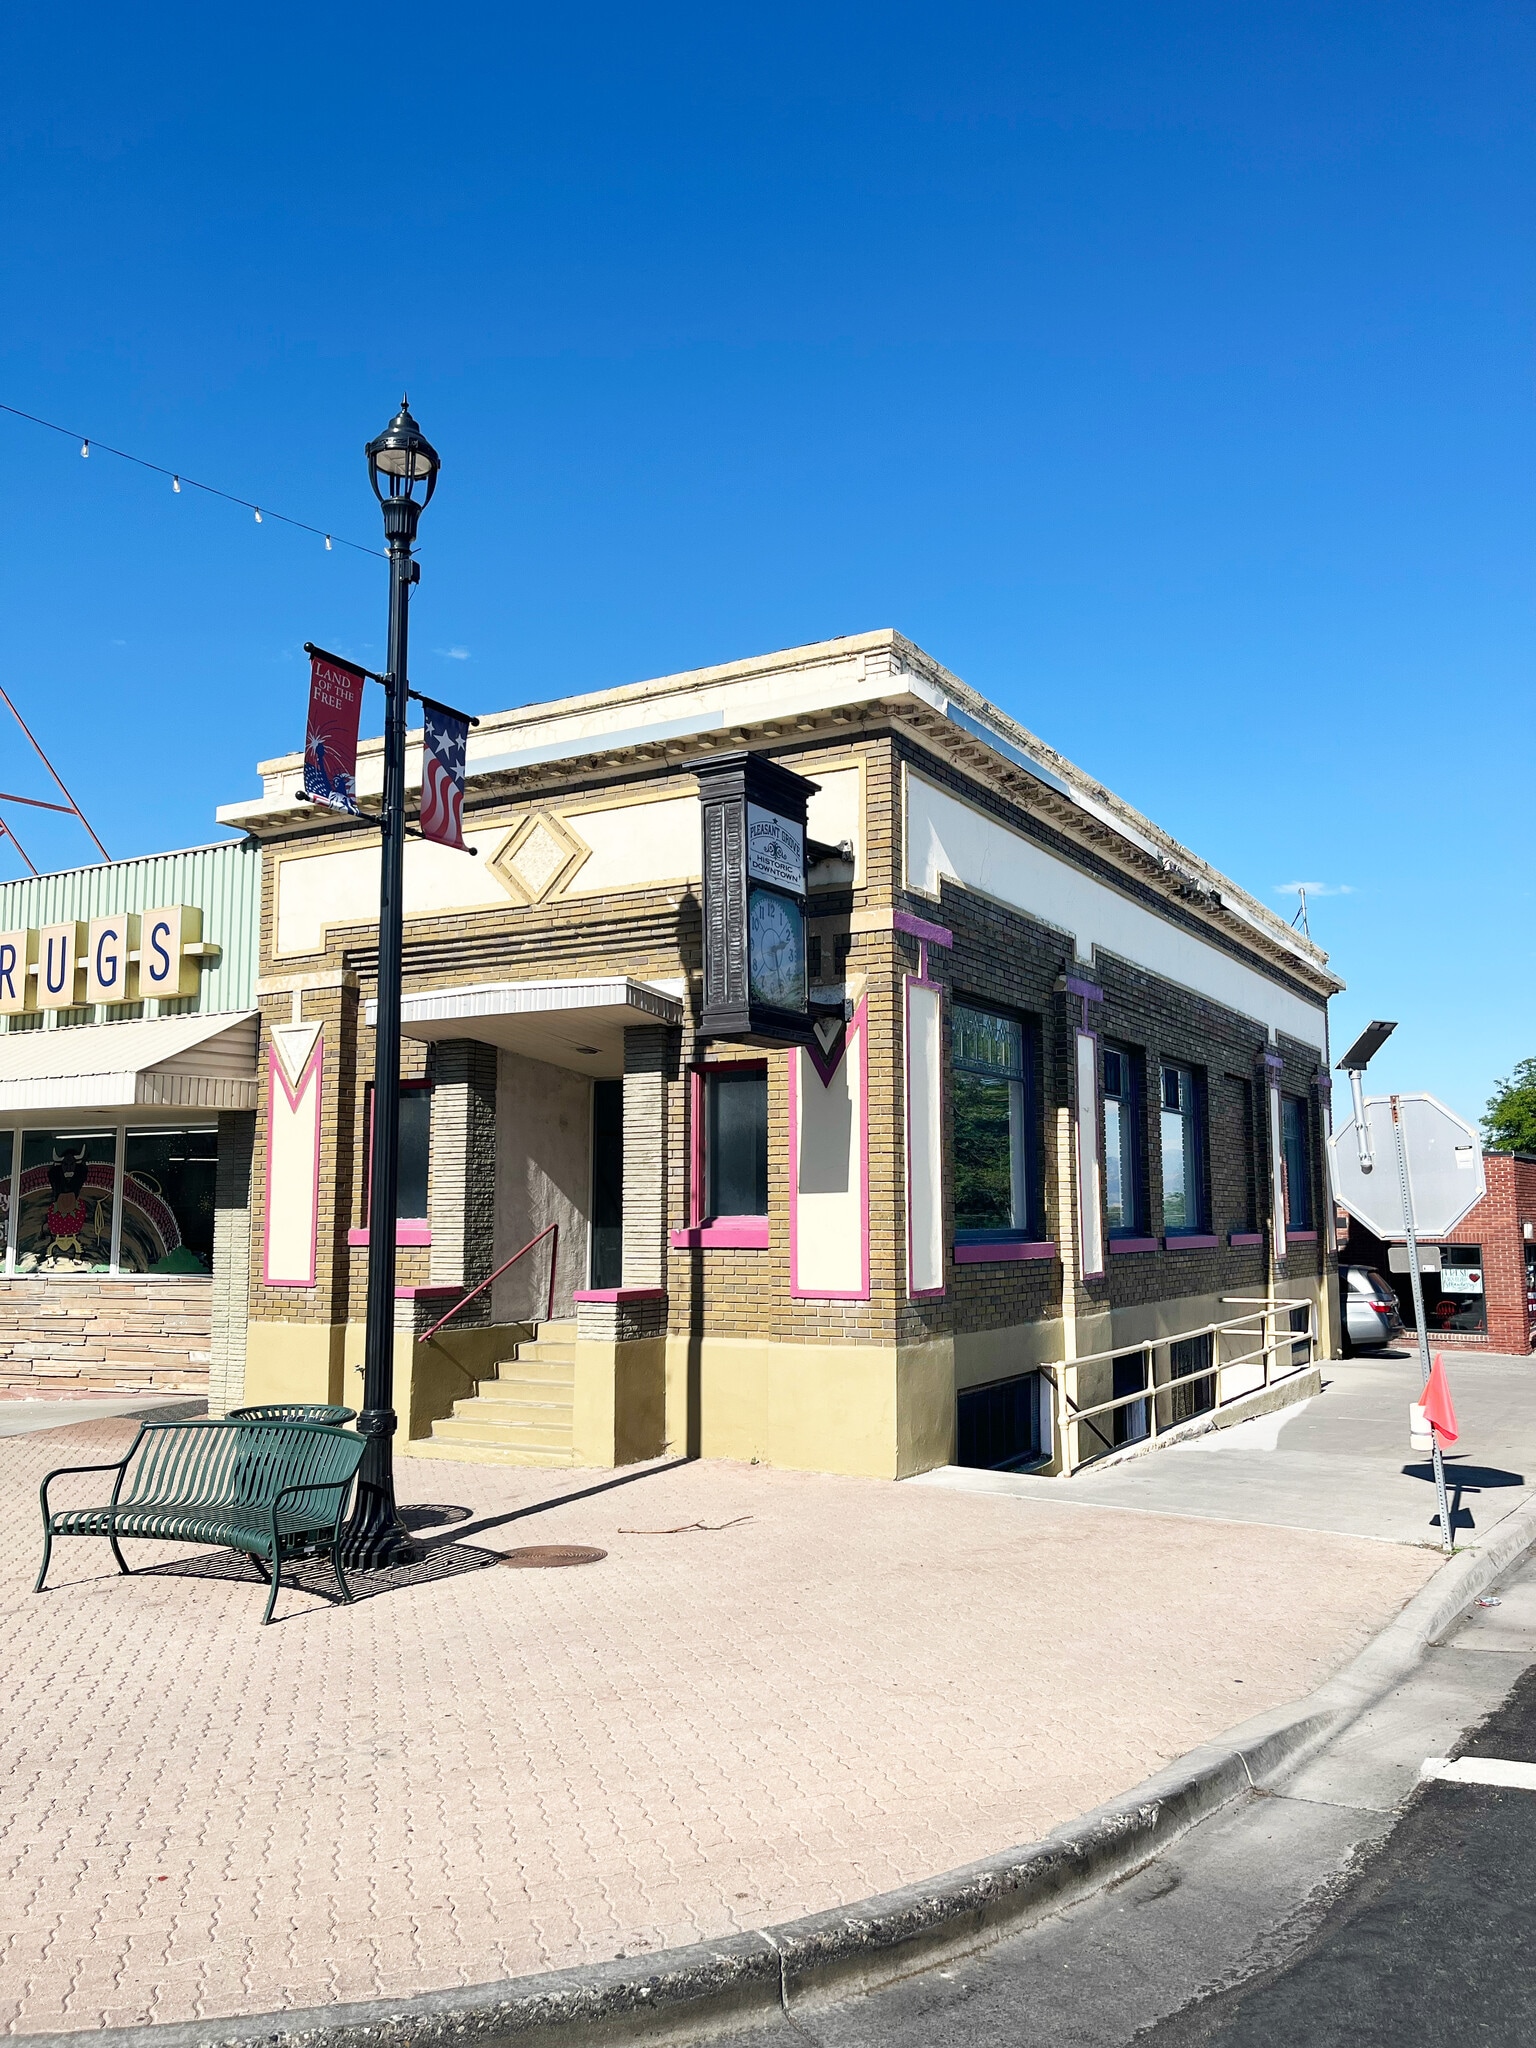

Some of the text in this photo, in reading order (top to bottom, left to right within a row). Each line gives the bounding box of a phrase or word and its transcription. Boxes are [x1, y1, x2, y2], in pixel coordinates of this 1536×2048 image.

[315, 662, 351, 688] LAND
[313, 686, 342, 710] FREE
[318, 680, 354, 702] OF THE
[750, 823, 801, 857] PLEASANT GROVE
[752, 860, 798, 882] DOWNTOWN
[756, 854, 793, 874] HISTORIC
[759, 905, 765, 920] 11
[767, 902, 775, 919] 12
[751, 916, 760, 931] 10
[785, 928, 791, 942] 2
[0, 922, 171, 999] RUGS
[752, 958, 758, 972] 8
[788, 948, 794, 962] 3
